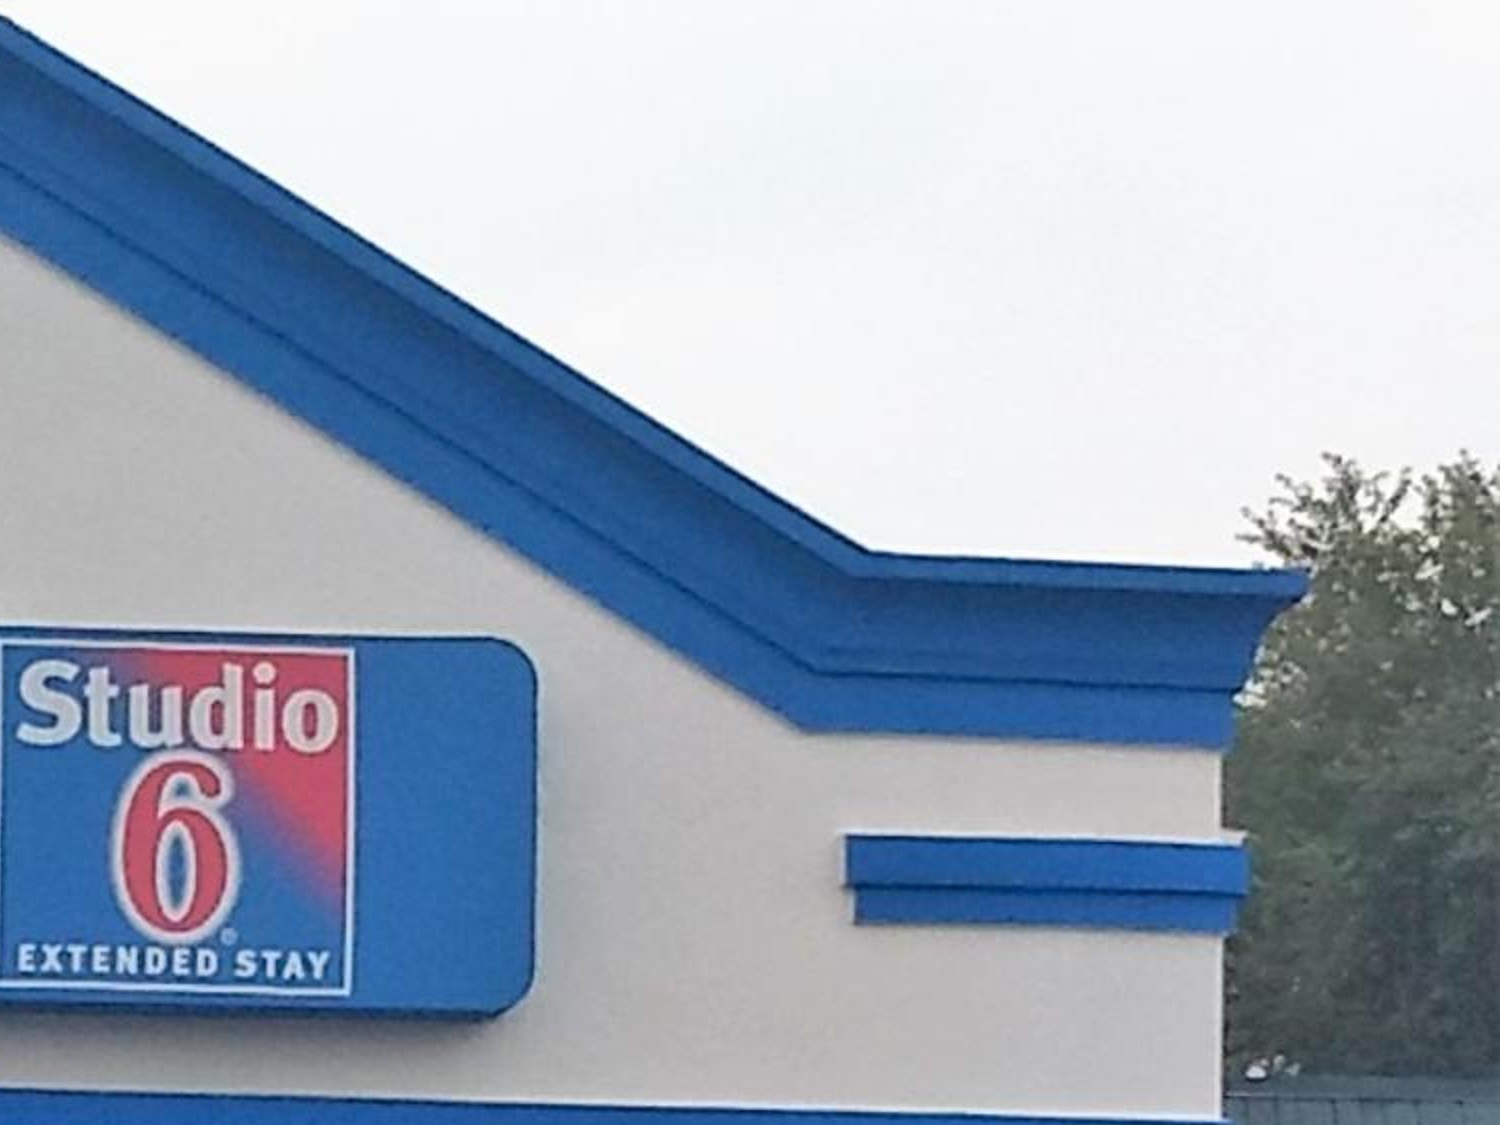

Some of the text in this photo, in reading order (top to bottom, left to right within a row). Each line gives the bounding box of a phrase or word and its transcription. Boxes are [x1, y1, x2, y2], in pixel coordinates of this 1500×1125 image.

[15, 658, 340, 754] Studio
[118, 758, 232, 937] 6
[17, 942, 331, 980] EXTENDED STAY
